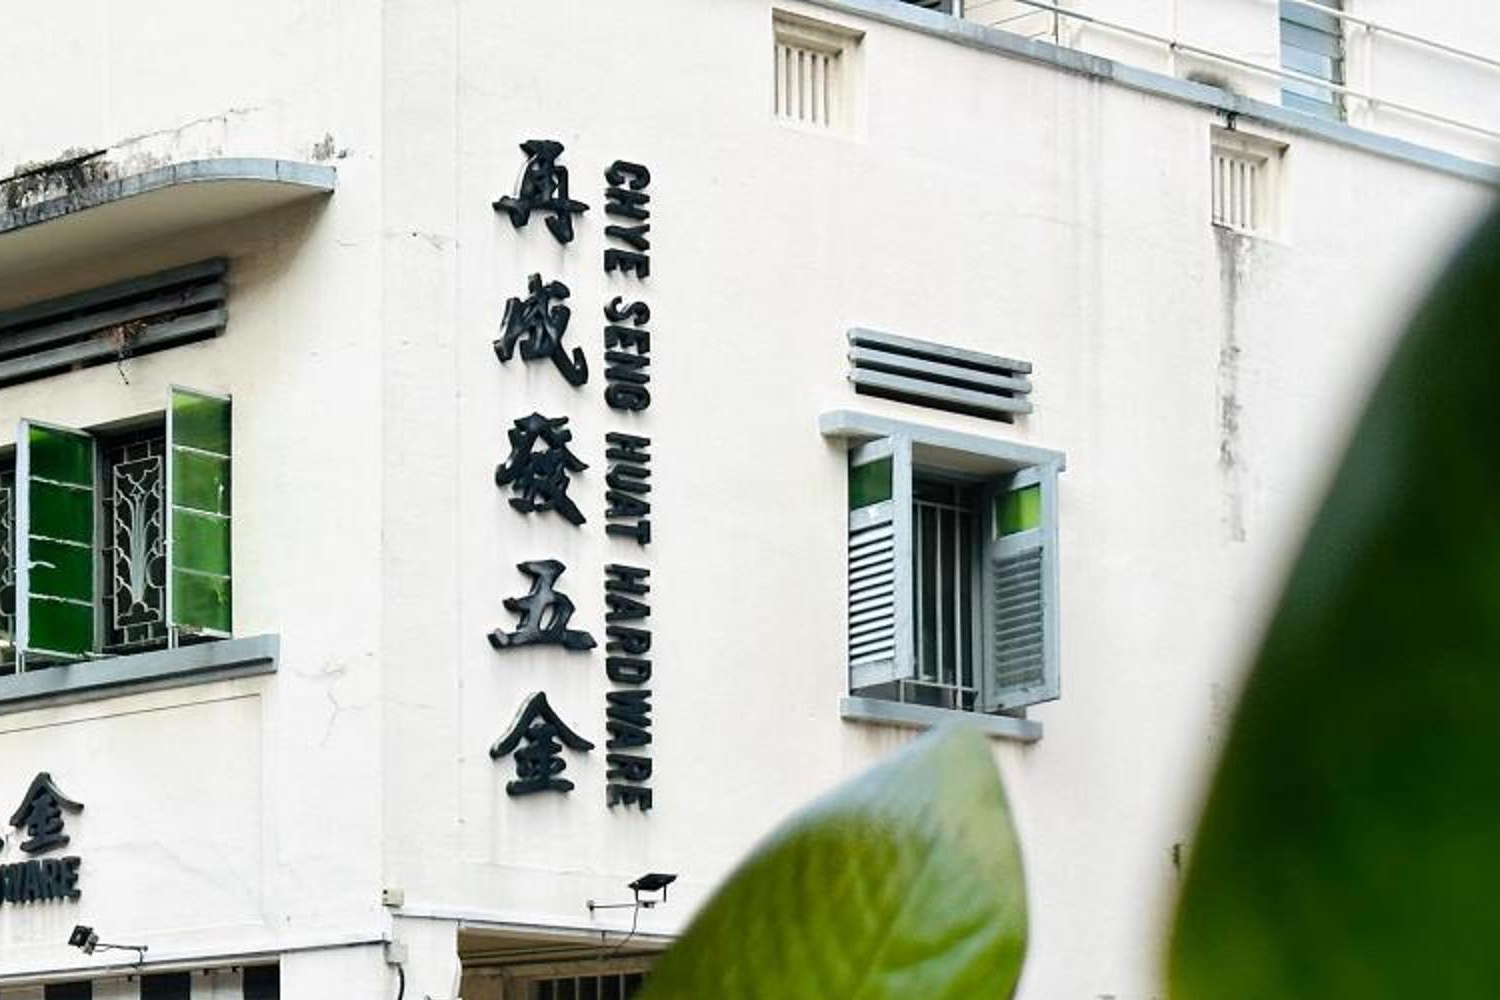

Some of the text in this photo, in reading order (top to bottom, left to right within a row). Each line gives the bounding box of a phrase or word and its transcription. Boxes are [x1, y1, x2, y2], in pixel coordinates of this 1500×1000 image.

[604, 159, 652, 811] CHYE SENG HUAT HARDWARE
